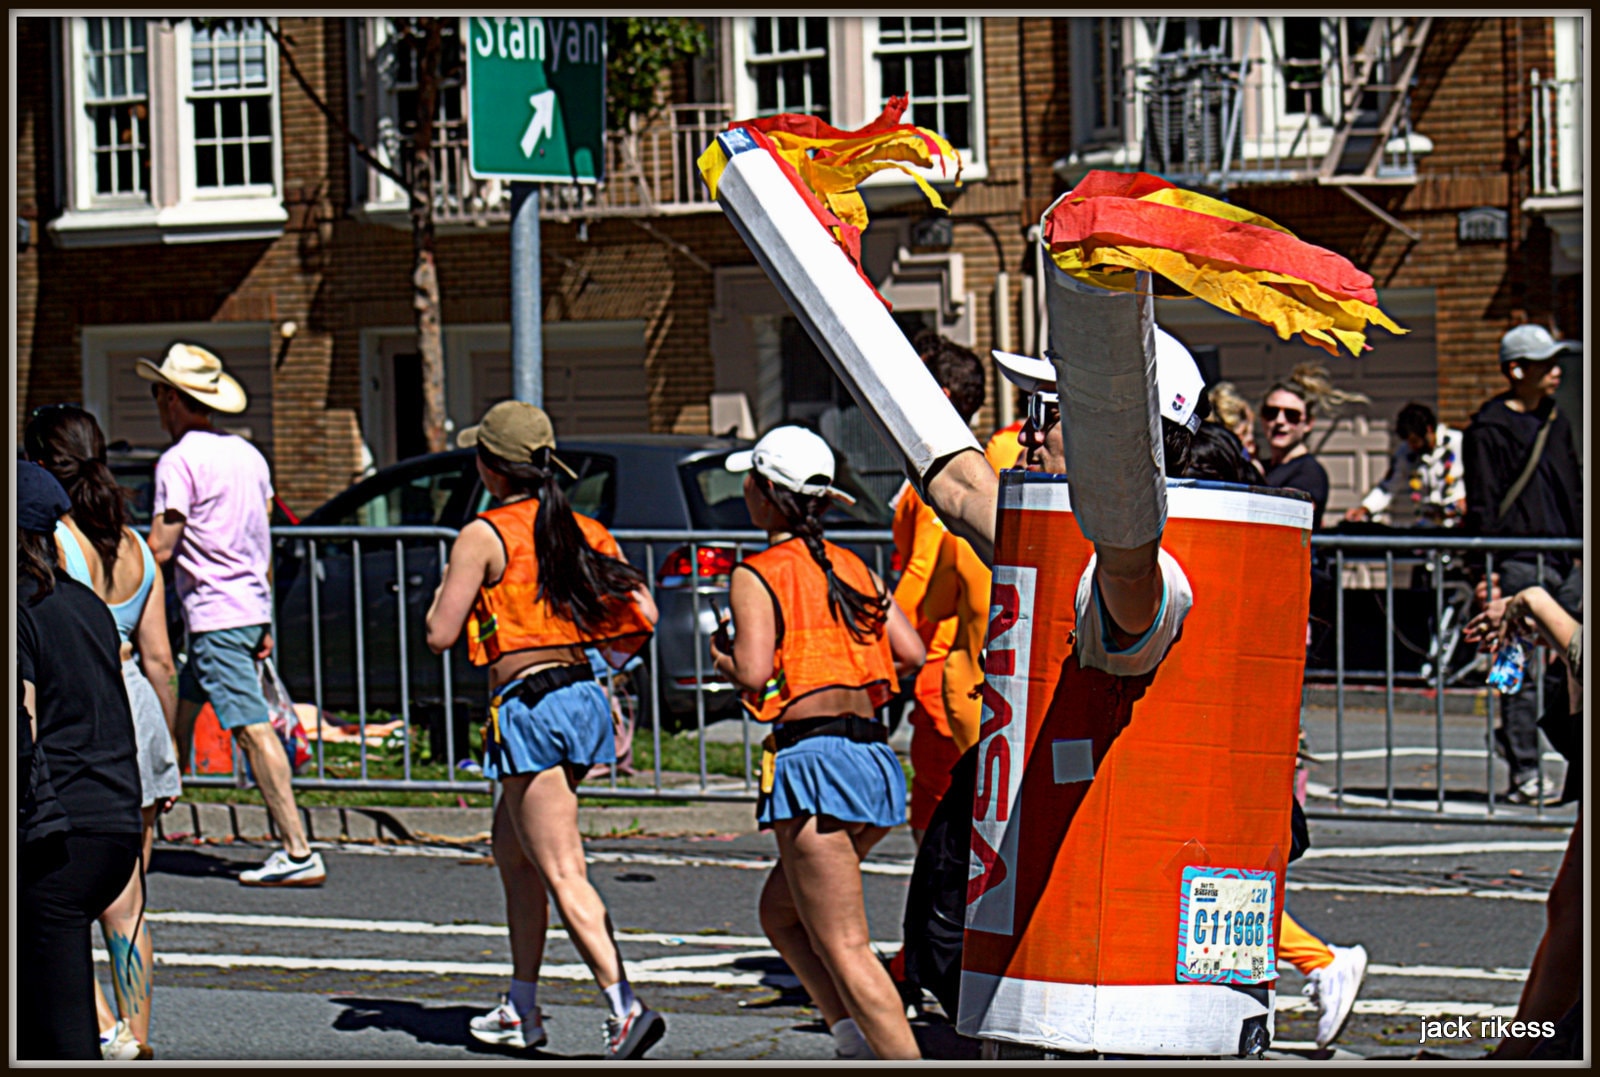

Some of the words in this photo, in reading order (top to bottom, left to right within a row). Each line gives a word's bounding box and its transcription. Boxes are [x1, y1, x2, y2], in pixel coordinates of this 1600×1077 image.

[476, 17, 599, 72] Stanyan
[967, 584, 1020, 906] NASA
[1194, 908, 1265, 946] C11986
